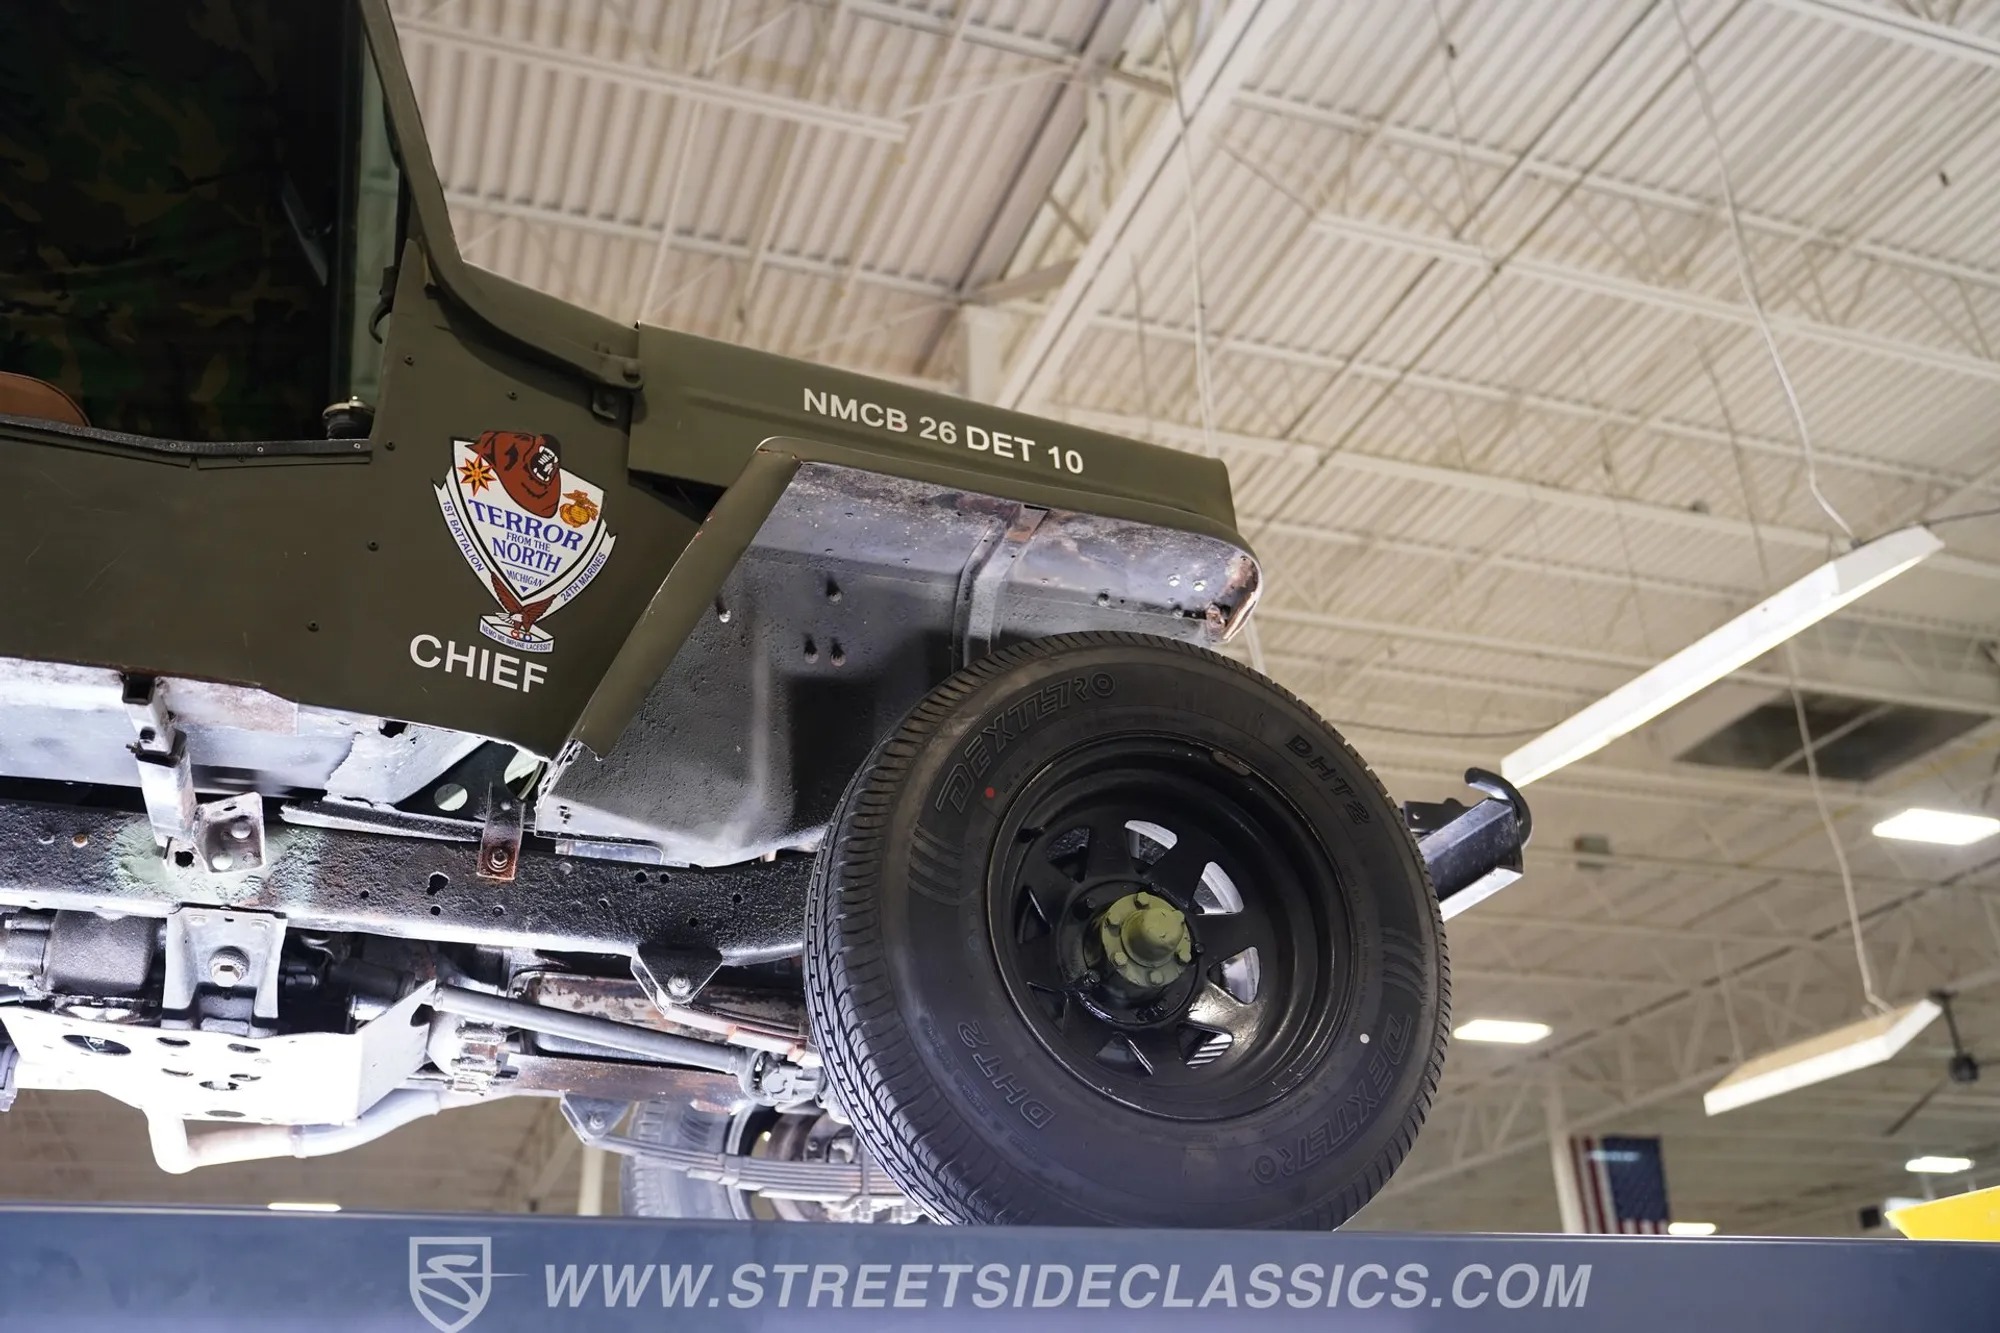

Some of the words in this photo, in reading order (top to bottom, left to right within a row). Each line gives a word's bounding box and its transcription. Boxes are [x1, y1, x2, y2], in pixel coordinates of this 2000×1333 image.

[803, 388, 908, 433] NMCB
[918, 416, 958, 444] 26
[965, 425, 1036, 462] DET
[1047, 445, 1084, 474] 10
[443, 501, 456, 517] 1ST
[450, 519, 485, 572] BATTALION
[468, 499, 584, 551] TERROR
[506, 532, 532, 546] FROM
[534, 540, 552, 552] THE
[492, 536, 563, 574] NORTH
[506, 569, 545, 587] MICHIGAN
[560, 582, 581, 602] 24TH
[578, 551, 607, 586] MARINES
[481, 624, 497, 639] NEMO
[409, 634, 548, 693] CHIEF
[935, 672, 1116, 814] DEXTERO
[544, 1262, 1593, 1309] WWW.STREETSIDECLASSICS.COM
